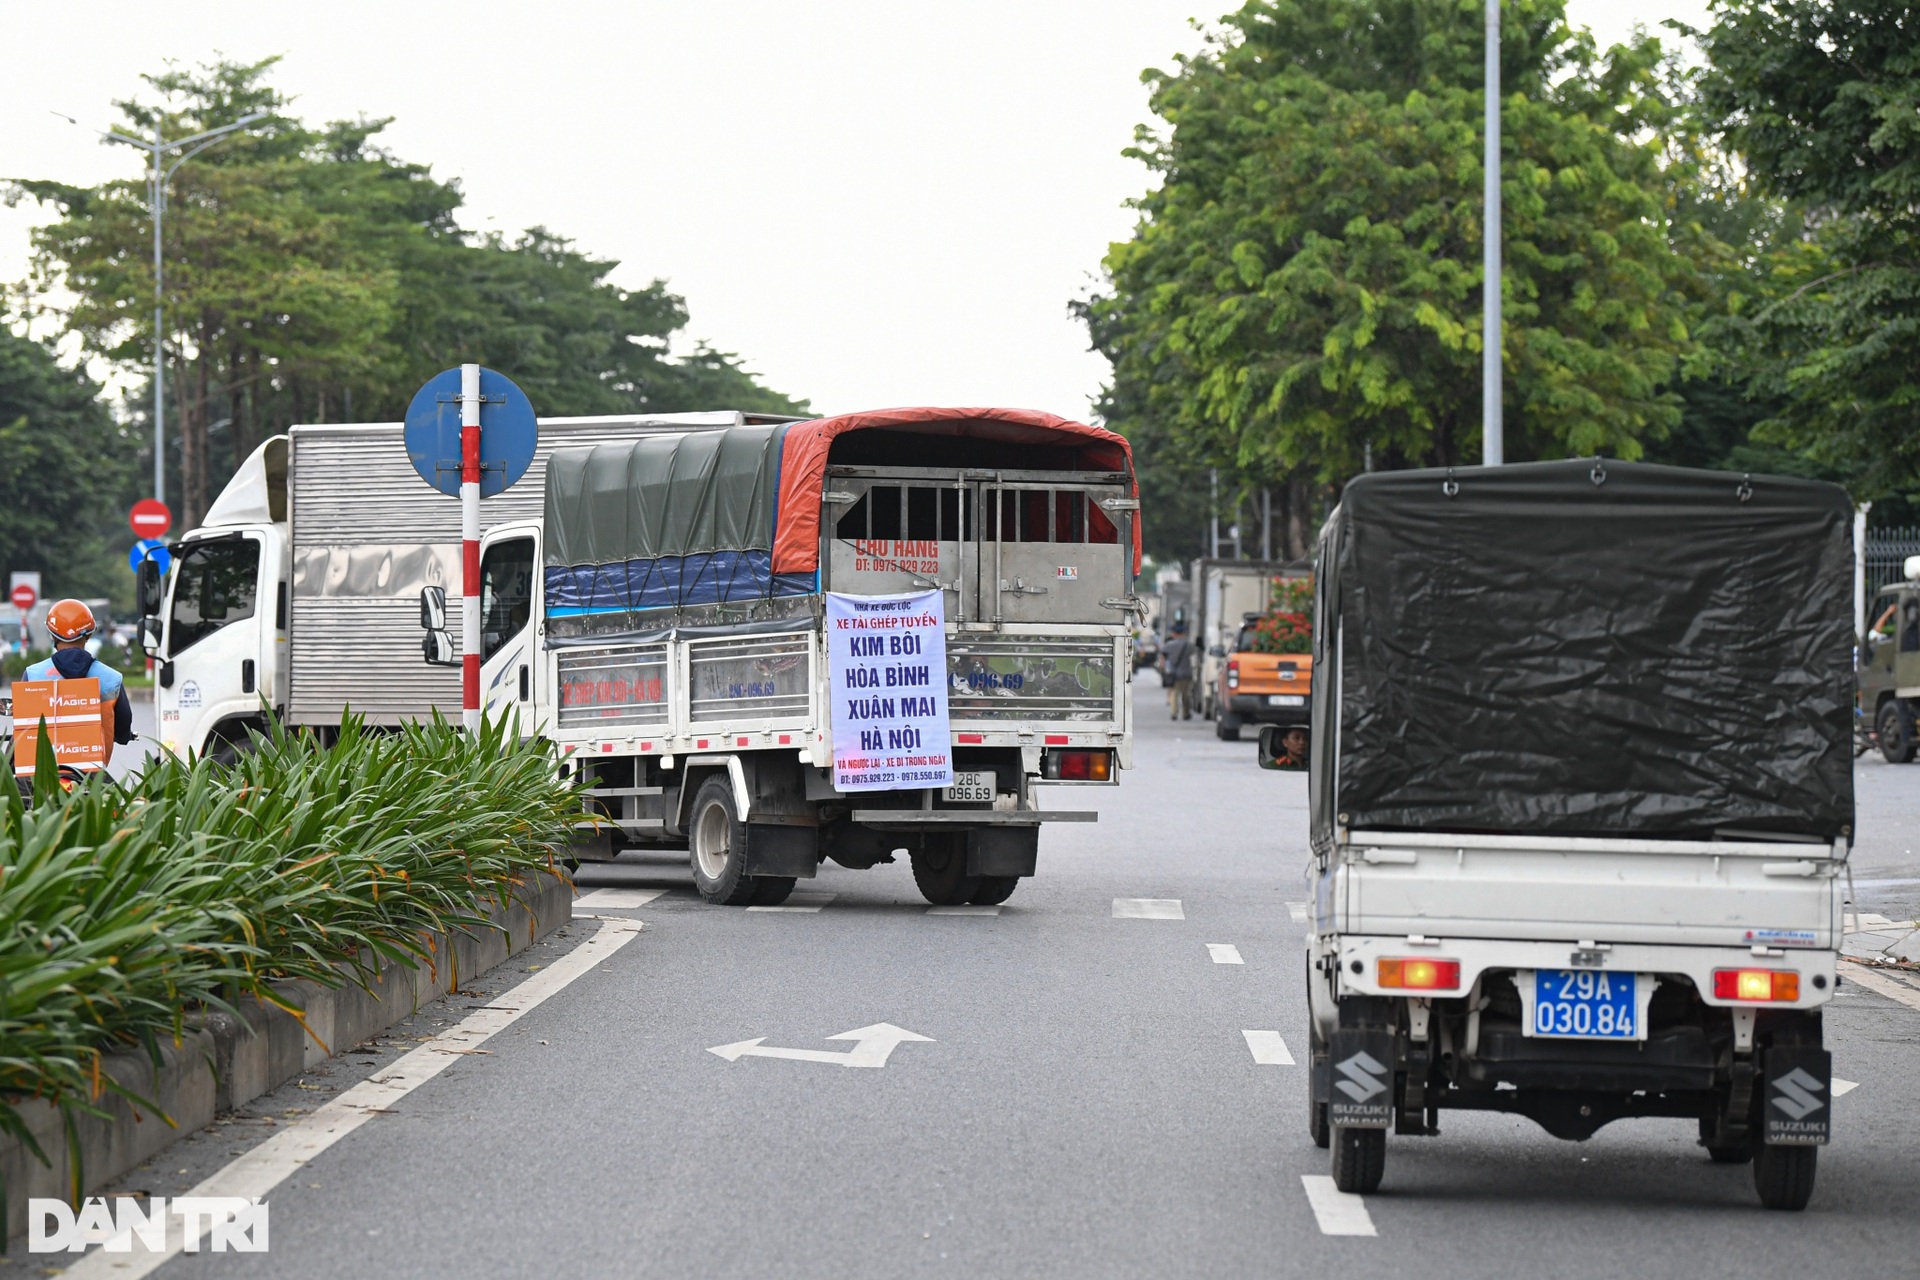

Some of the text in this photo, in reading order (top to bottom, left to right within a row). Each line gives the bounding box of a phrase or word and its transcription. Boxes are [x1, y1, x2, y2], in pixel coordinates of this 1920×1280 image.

[855, 558, 939, 574] ĐT: 0975 929 223
[1057, 567, 1077, 577] HLX
[870, 603, 880, 611] XE
[836, 618, 849, 630] XE
[870, 615, 898, 629] GHÉP
[900, 611, 937, 628] TUYẾN
[849, 631, 921, 657] KIM BÔI
[845, 662, 929, 689] HÒA BÌNH
[49, 697, 88, 707] MAGIC
[847, 694, 937, 720] XUÂN MAI
[860, 724, 921, 754] HÀ NỘI
[837, 757, 847, 770] VÀ
[886, 757, 895, 768] XE
[896, 757, 904, 767] ĐI
[905, 756, 928, 767] TRONG
[928, 754, 946, 766] NGÀY
[840, 775, 851, 784] ĐT:
[851, 773, 895, 784] 0975.929.223
[901, 771, 947, 781] 0978.550.697
[958, 773, 981, 786] 28C
[949, 787, 991, 800] 096.69
[1558, 970, 1612, 1001] 29A
[1536, 1001, 1633, 1036] 030.84
[1332, 1104, 1389, 1115] SUZUKI
[1769, 1120, 1826, 1132] SUZUKI
